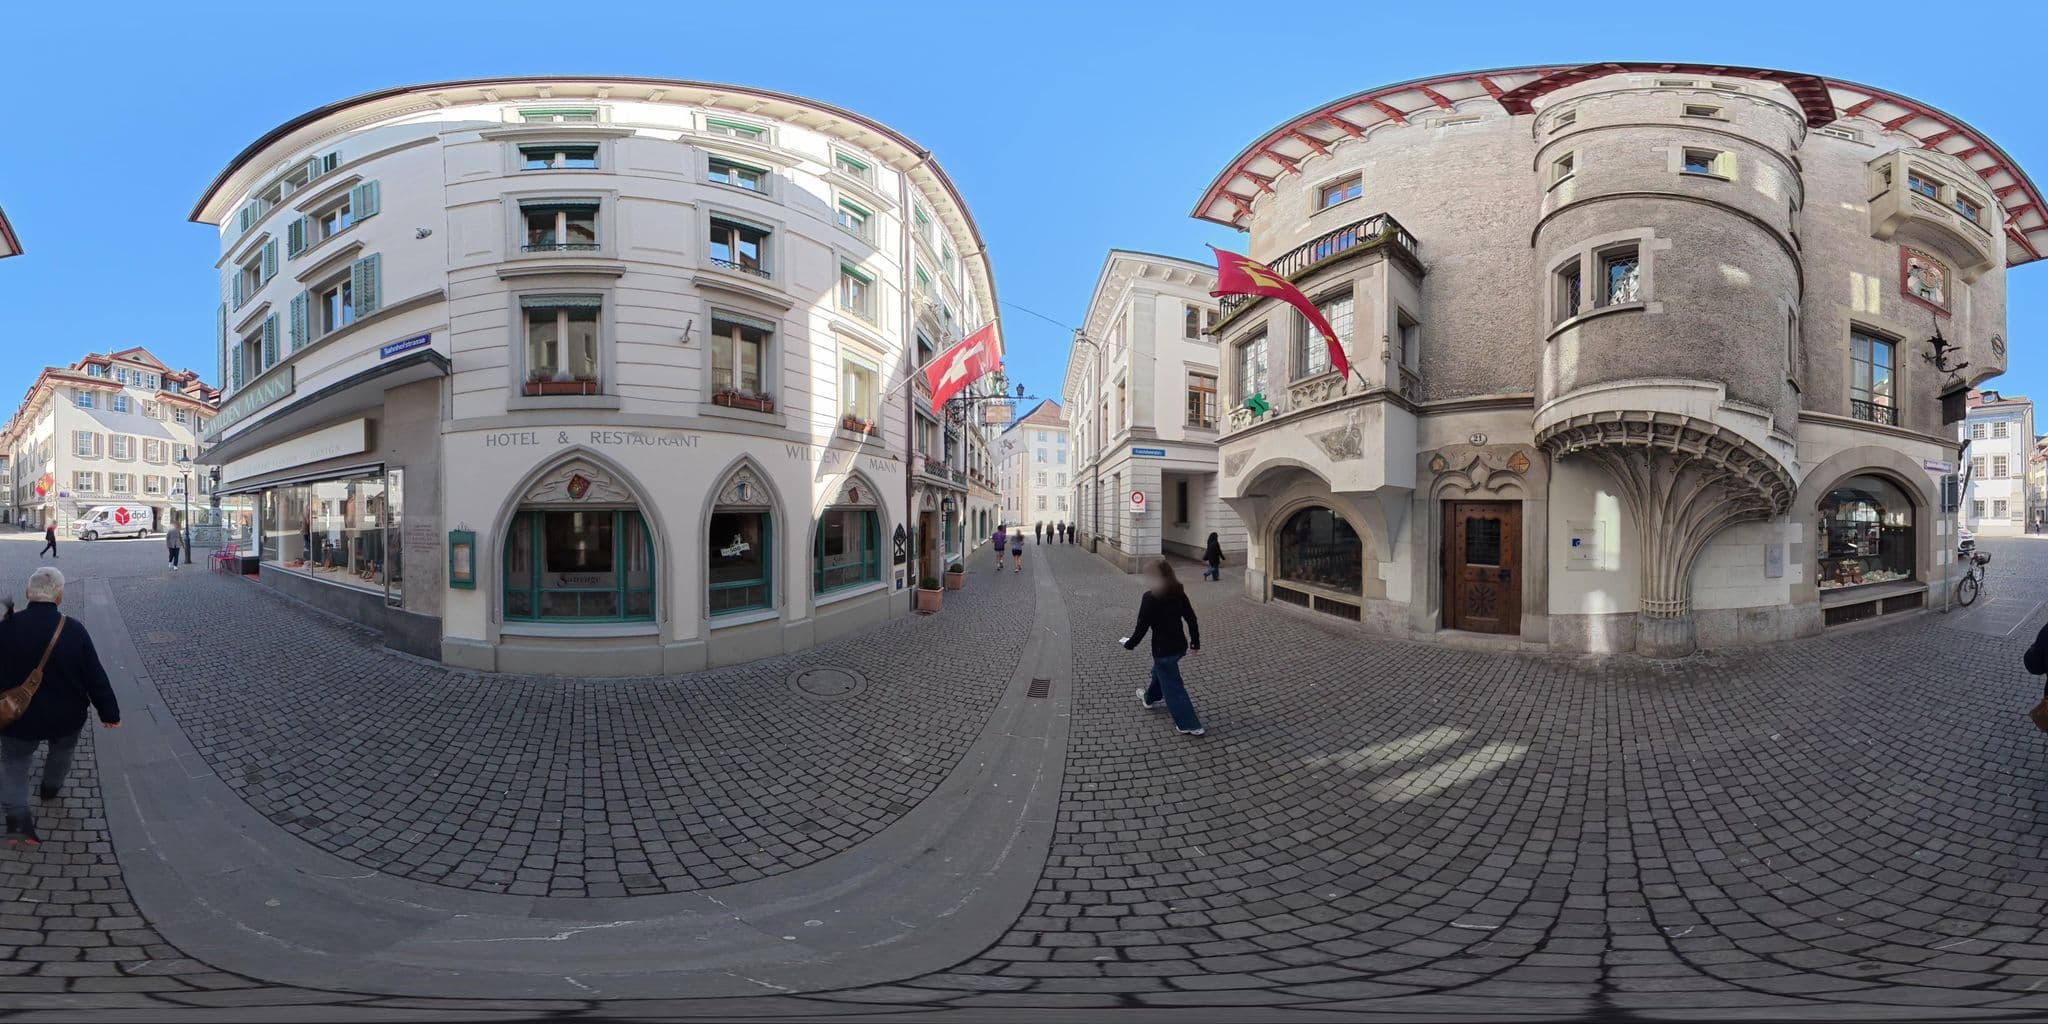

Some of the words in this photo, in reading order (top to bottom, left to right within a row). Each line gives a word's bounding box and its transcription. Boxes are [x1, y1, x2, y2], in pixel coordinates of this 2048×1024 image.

[383, 336, 427, 356] Bahnhofstrasse
[245, 372, 289, 412] MANN
[486, 431, 540, 447] HOTEL
[558, 431, 569, 444] &
[590, 431, 702, 448] RESTAURANT
[785, 444, 840, 465] WILDEN
[869, 458, 897, 473] MANN
[131, 510, 147, 521] dpd
